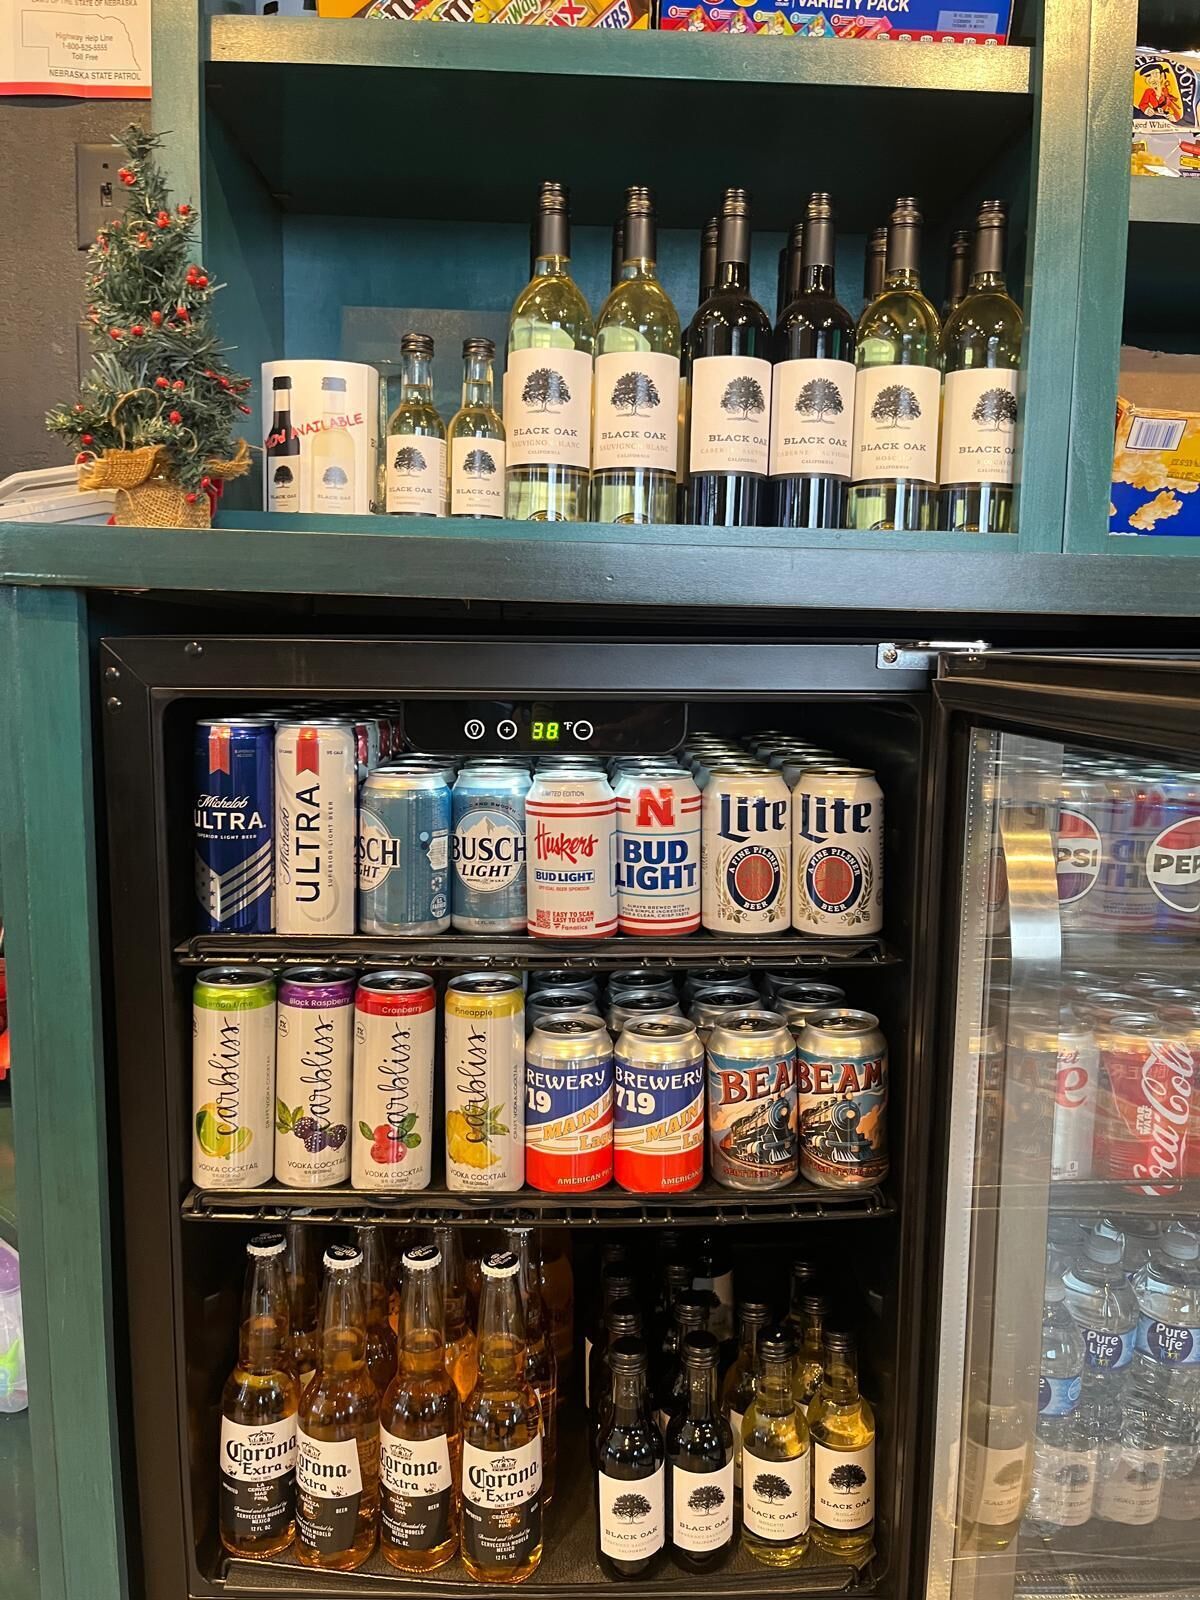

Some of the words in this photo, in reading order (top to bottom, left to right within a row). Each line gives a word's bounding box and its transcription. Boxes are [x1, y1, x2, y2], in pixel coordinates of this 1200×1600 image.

[866, 0, 910, 12] PACK
[85, 34, 99, 43] Help
[49, 70, 89, 79] NEBRASKA
[91, 72, 112, 80] STATE
[1149, 120, 1171, 129] White
[291, 412, 364, 440] AVAILABLE
[513, 427, 550, 437] BLACK
[555, 428, 578, 437] OAK
[602, 431, 639, 440] BLACK
[643, 431, 667, 440] OAK
[708, 434, 750, 443] BLACK
[784, 437, 825, 446] BLACK
[829, 438, 848, 447] OAK
[861, 443, 899, 452] BLACK
[904, 442, 927, 452] OAK
[959, 446, 1001, 455] BLACK
[533, 722, 559, 740] 38
[197, 794, 250, 809] Michelob
[636, 788, 675, 827] N
[194, 808, 264, 830] ULTRA
[717, 793, 787, 843] Lite
[798, 793, 872, 844] Lite
[279, 806, 291, 885] Michelob
[296, 784, 320, 902] ULTRA
[534, 820, 599, 864] Huskers
[623, 839, 689, 865] BUD
[729, 866, 735, 874] A
[732, 848, 751, 866] FINE
[753, 846, 779, 873] PILSNER
[808, 866, 814, 874] A
[811, 849, 829, 866] FINE
[831, 848, 860, 876] PILSNER
[461, 864, 513, 877] LIGHT
[536, 871, 557, 881] BUD
[615, 862, 697, 891] LIGHT
[743, 901, 768, 910] BEER
[821, 903, 847, 912] BEER
[289, 997, 310, 1006] Black
[311, 997, 350, 1008] Raspberry
[382, 1004, 423, 1014] Cranberry
[455, 1006, 493, 1016] Pineapple
[615, 1065, 703, 1091] BREWERY
[799, 1059, 883, 1095] BEAM
[615, 1087, 656, 1115] 719
[543, 1103, 599, 1141] MAIN
[645, 1105, 699, 1143] MAIN
[288, 1160, 312, 1170] VODKA
[314, 1158, 347, 1170] COCKTAIL
[364, 1169, 389, 1179] VODKA
[450, 1168, 469, 1180] VODKA
[471, 1172, 508, 1181] COCKTAIL
[557, 1174, 600, 1185] AMERICAN
[661, 1171, 700, 1185] AMERICAN
[1087, 1330, 1119, 1345] Pure
[1156, 1323, 1189, 1339] Pure
[1158, 1334, 1183, 1350] Life
[1089, 1344, 1114, 1357] Life
[226, 1434, 296, 1466] Corona
[243, 1462, 281, 1476] Extra
[385, 1471, 419, 1491] Extra
[468, 1461, 538, 1493] Corona
[248, 1485, 274, 1493] CERVEZA
[486, 1488, 524, 1503] Extra
[428, 1503, 440, 1511] BEER
[820, 1498, 853, 1509] BLACK
[855, 1498, 871, 1508] OAK
[236, 1512, 267, 1520] CERVECERIA
[267, 1507, 286, 1518] MODELO
[492, 1512, 517, 1520] CERVEZA
[746, 1503, 776, 1520] BLACK
[779, 1511, 798, 1520] OAK
[679, 1522, 712, 1531] BLACK
[714, 1517, 729, 1528] OAK
[313, 1529, 331, 1537] MODELO
[391, 1529, 409, 1539] MEXICO
[404, 1528, 424, 1536] MODELO
[605, 1528, 638, 1540] BLACK
[640, 1526, 658, 1538] OAK
[481, 1540, 511, 1548] CERVECERIA
[511, 1534, 529, 1546] MODELO
